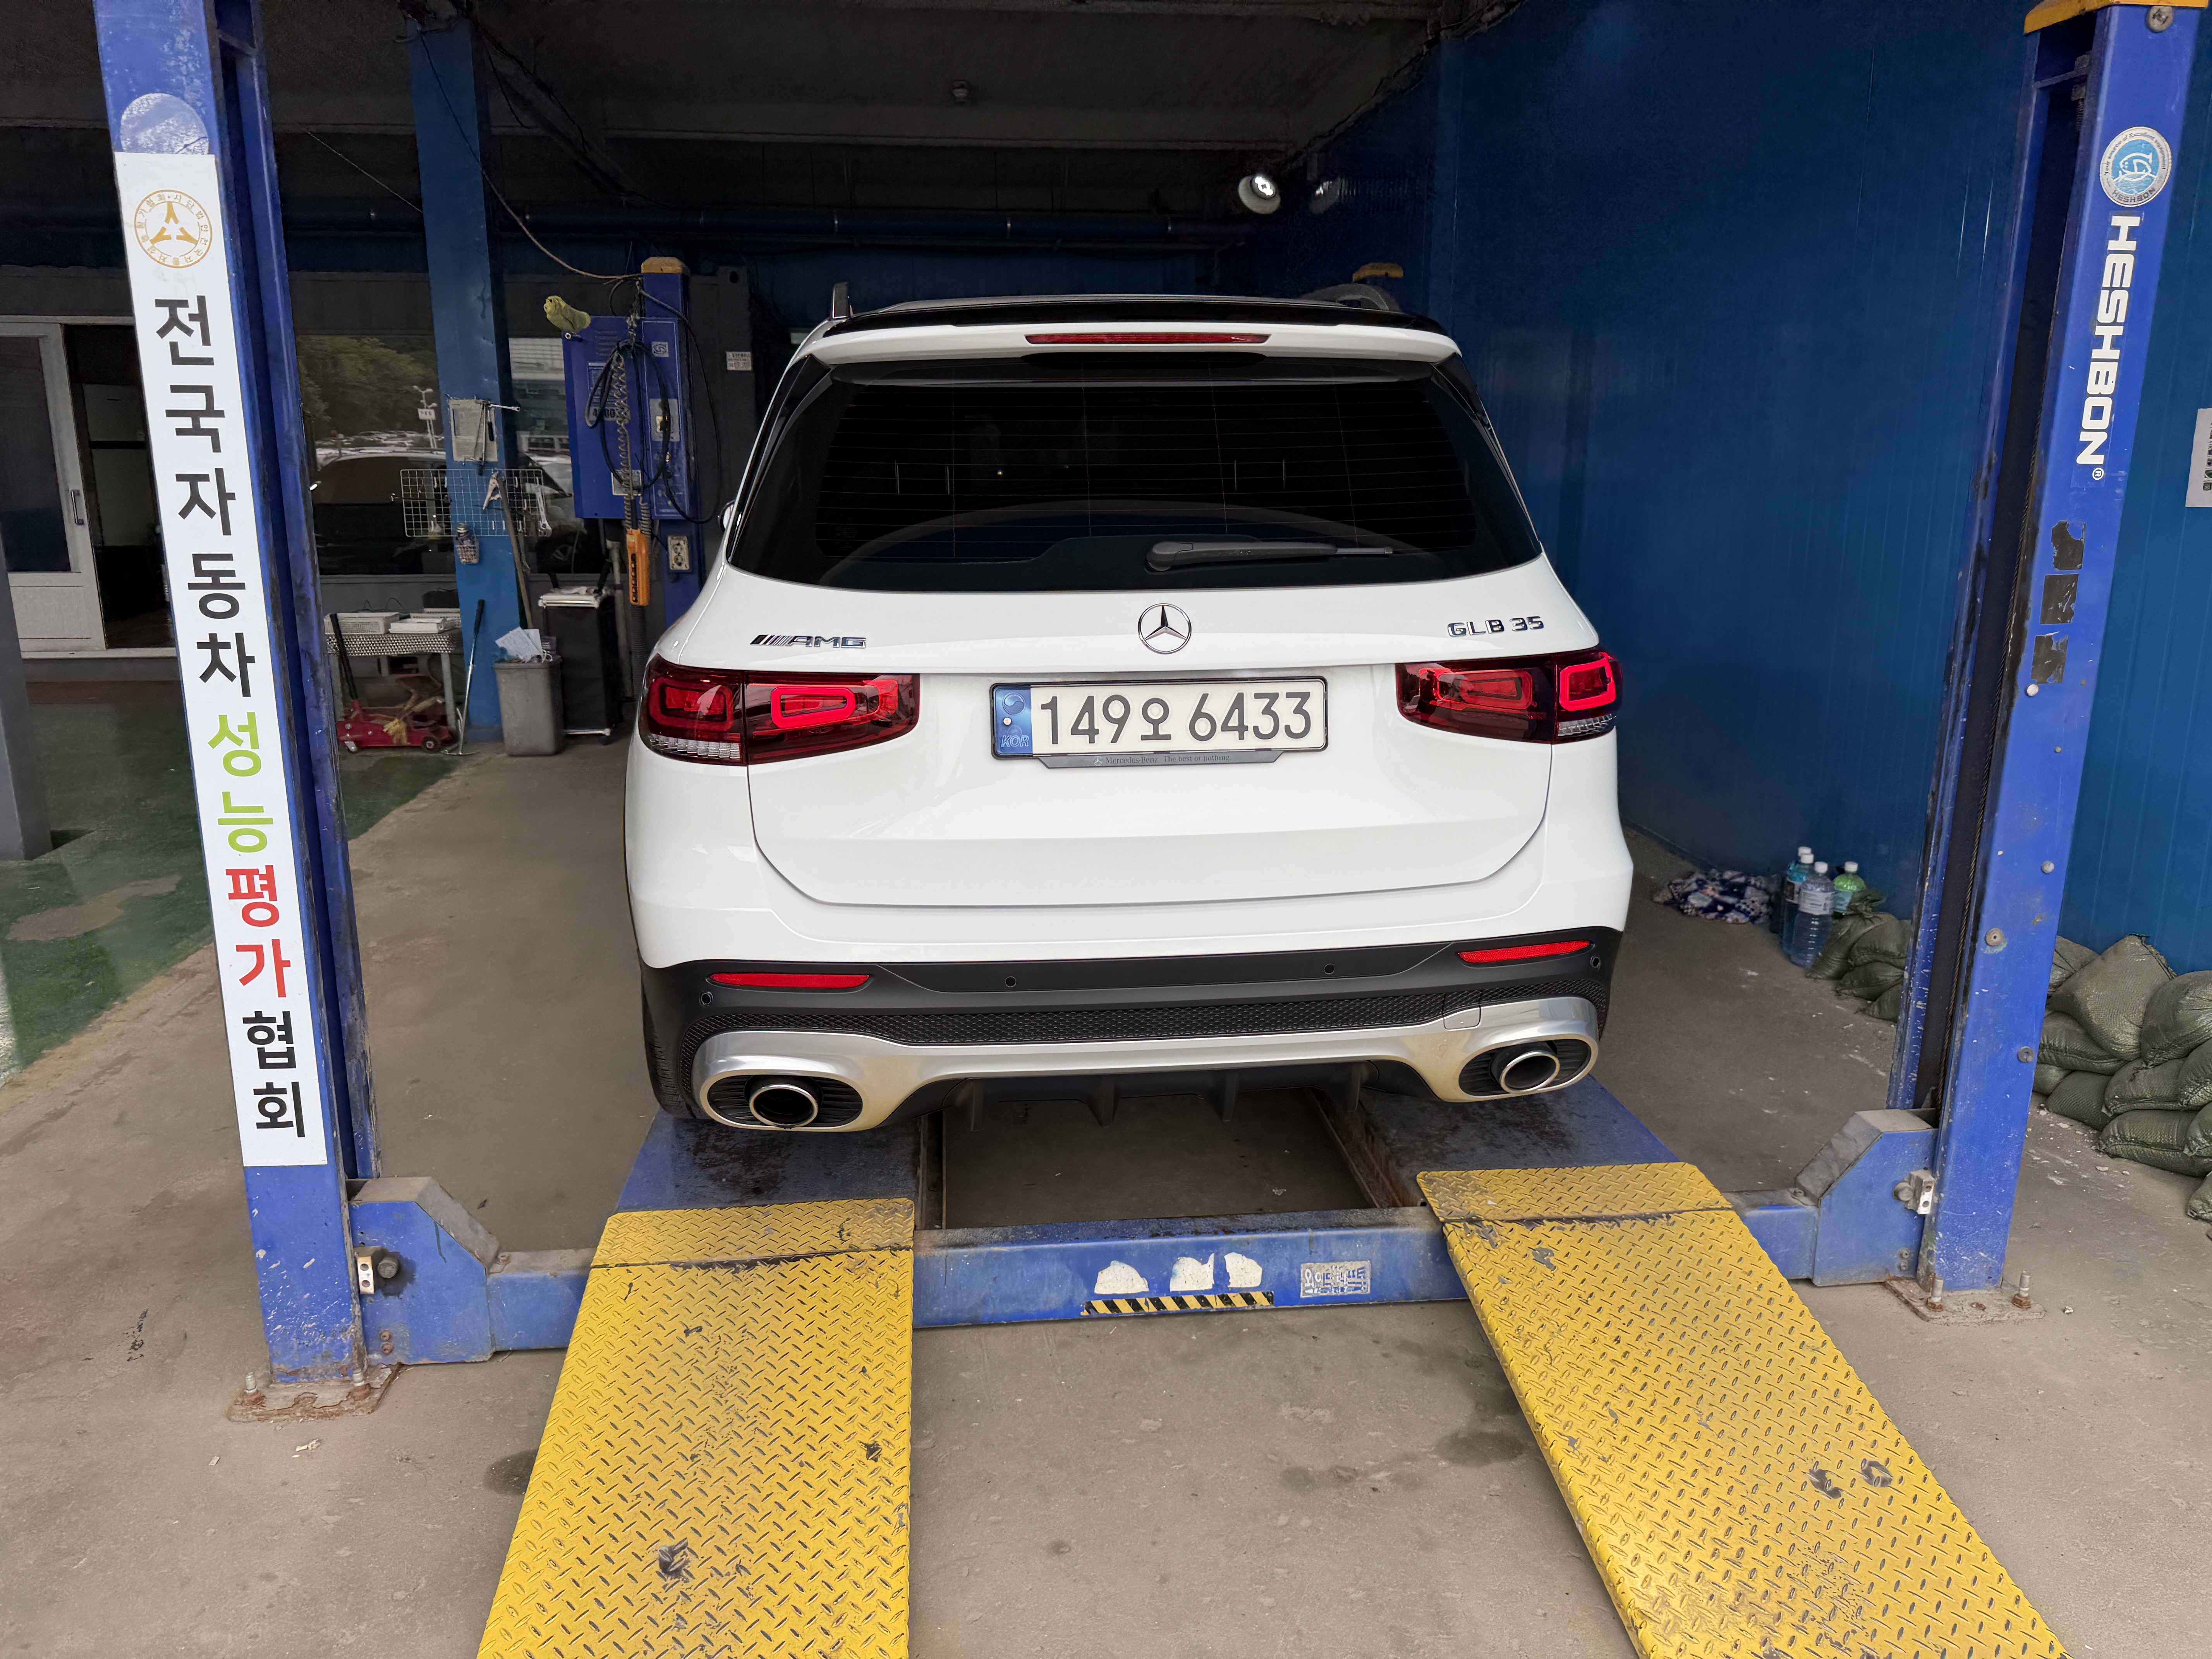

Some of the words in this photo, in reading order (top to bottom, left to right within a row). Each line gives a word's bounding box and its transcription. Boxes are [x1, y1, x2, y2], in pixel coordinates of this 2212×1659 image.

[2112, 187, 2155, 203] HESHBON
[1447, 619, 1504, 637] GLB
[1509, 616, 1544, 631] 35
[785, 635, 866, 649] AMG
[1040, 694, 1172, 745] 149오
[1189, 691, 1311, 742] 6433
[1001, 735, 1029, 747] KOR
[1106, 756, 1158, 764] Mercedes-Benz
